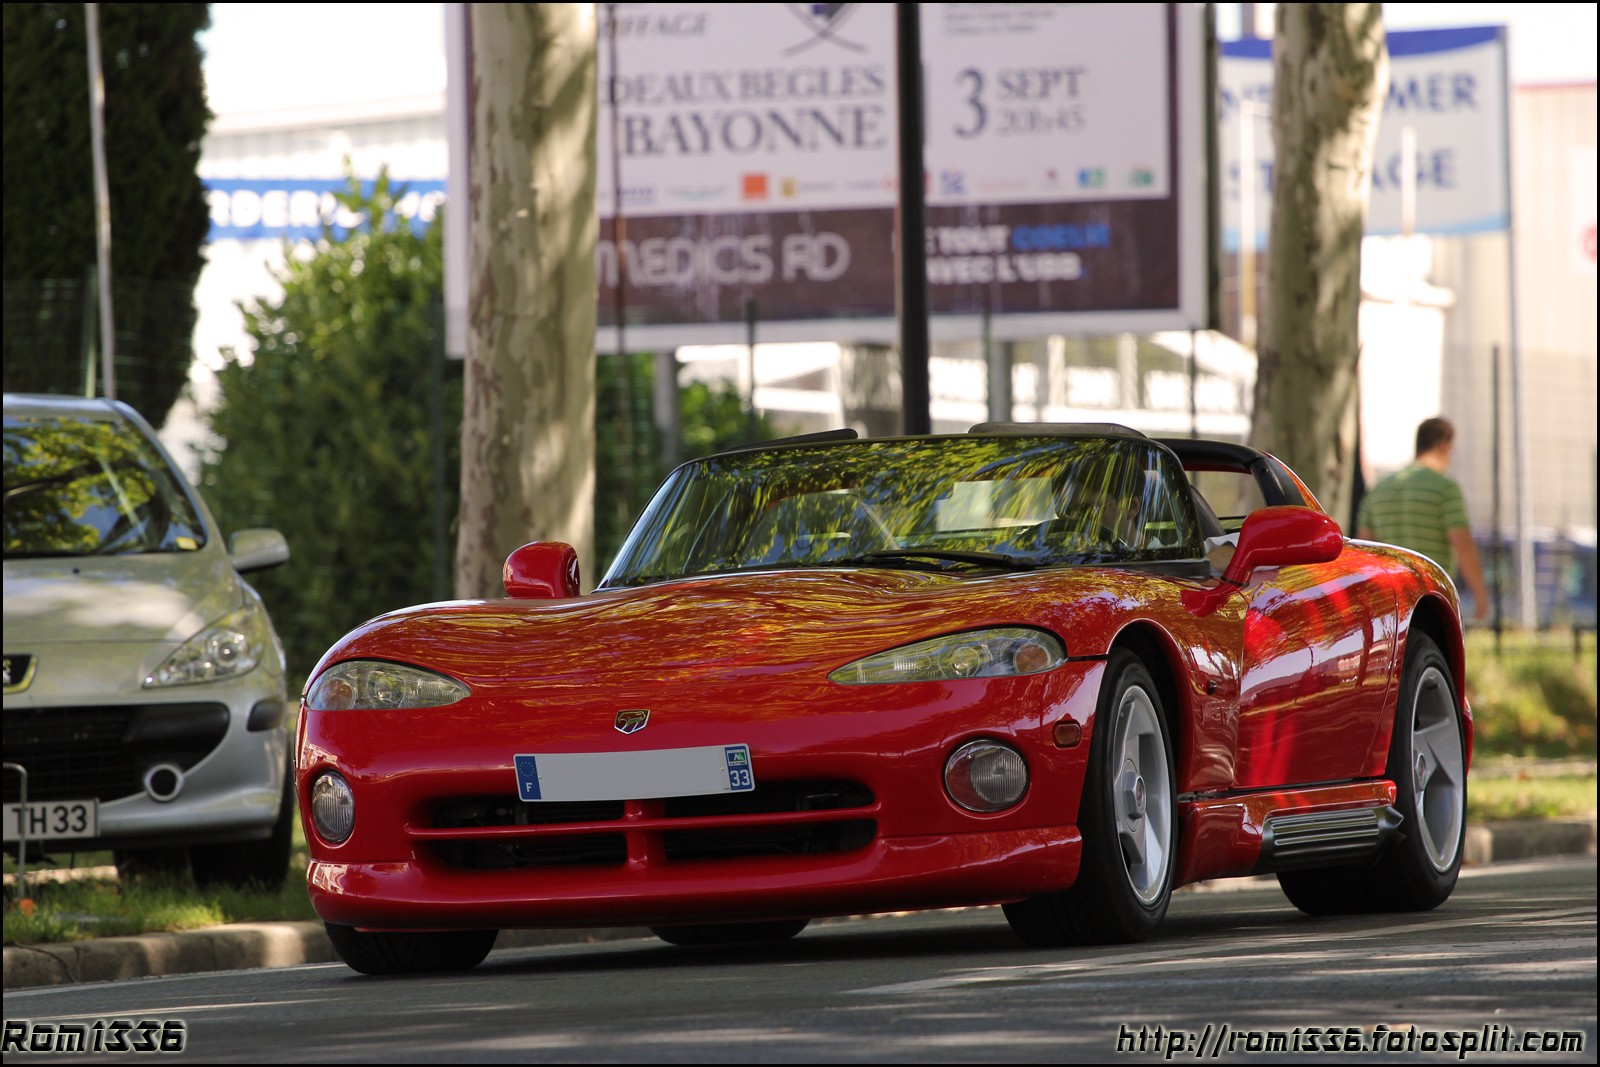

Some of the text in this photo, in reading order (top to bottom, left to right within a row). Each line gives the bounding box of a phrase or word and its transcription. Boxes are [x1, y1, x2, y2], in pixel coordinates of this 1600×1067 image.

[738, 65, 887, 99] BEGLES
[953, 66, 1087, 139] 3 SEPT
[619, 105, 888, 156] BAYONNE
[526, 782, 533, 793] F
[730, 769, 751, 787] 33
[11, 804, 88, 835] TH 33
